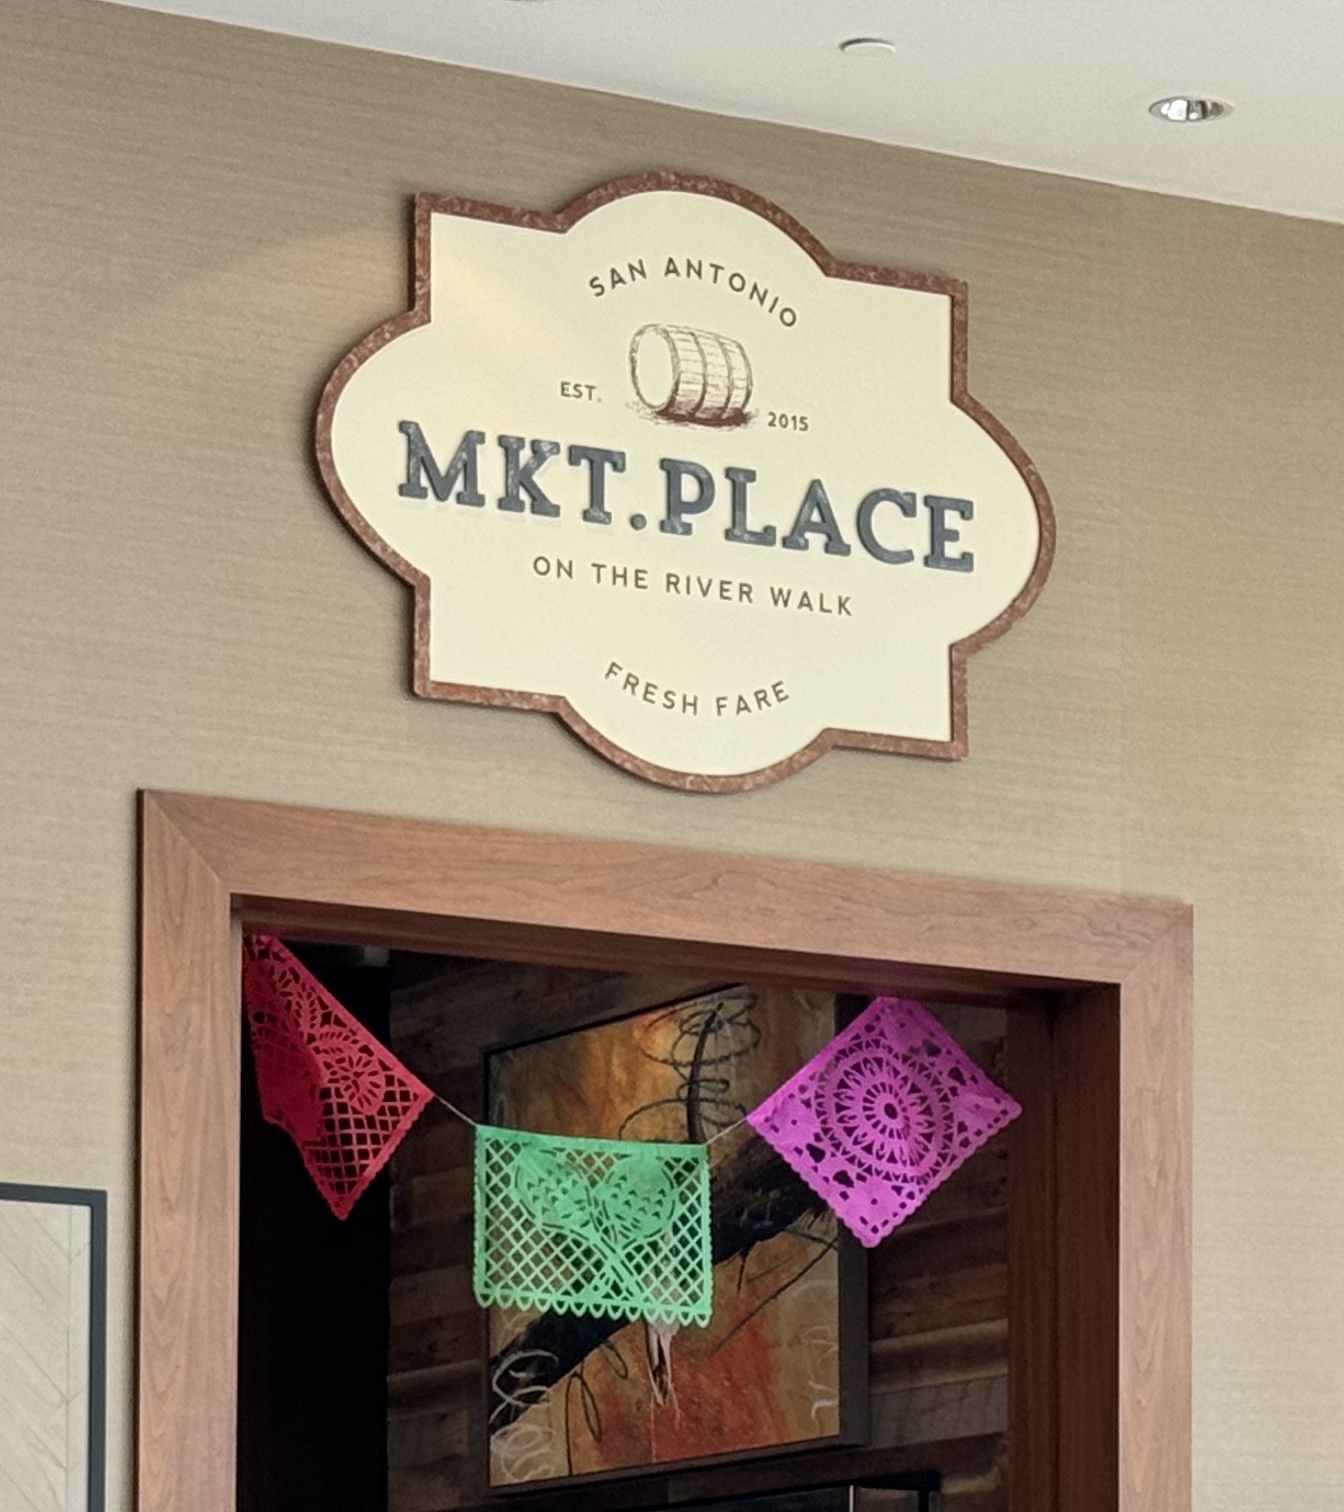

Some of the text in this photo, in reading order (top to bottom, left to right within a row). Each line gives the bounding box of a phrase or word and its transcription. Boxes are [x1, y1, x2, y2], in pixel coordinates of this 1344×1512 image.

[589, 256, 798, 329] SAN ANTONIO
[559, 381, 810, 433] EST. 2015
[397, 420, 975, 573] MKT.PLACE
[532, 555, 854, 617] ON THE RIVER WALK
[604, 660, 791, 718] FRESH FARE
